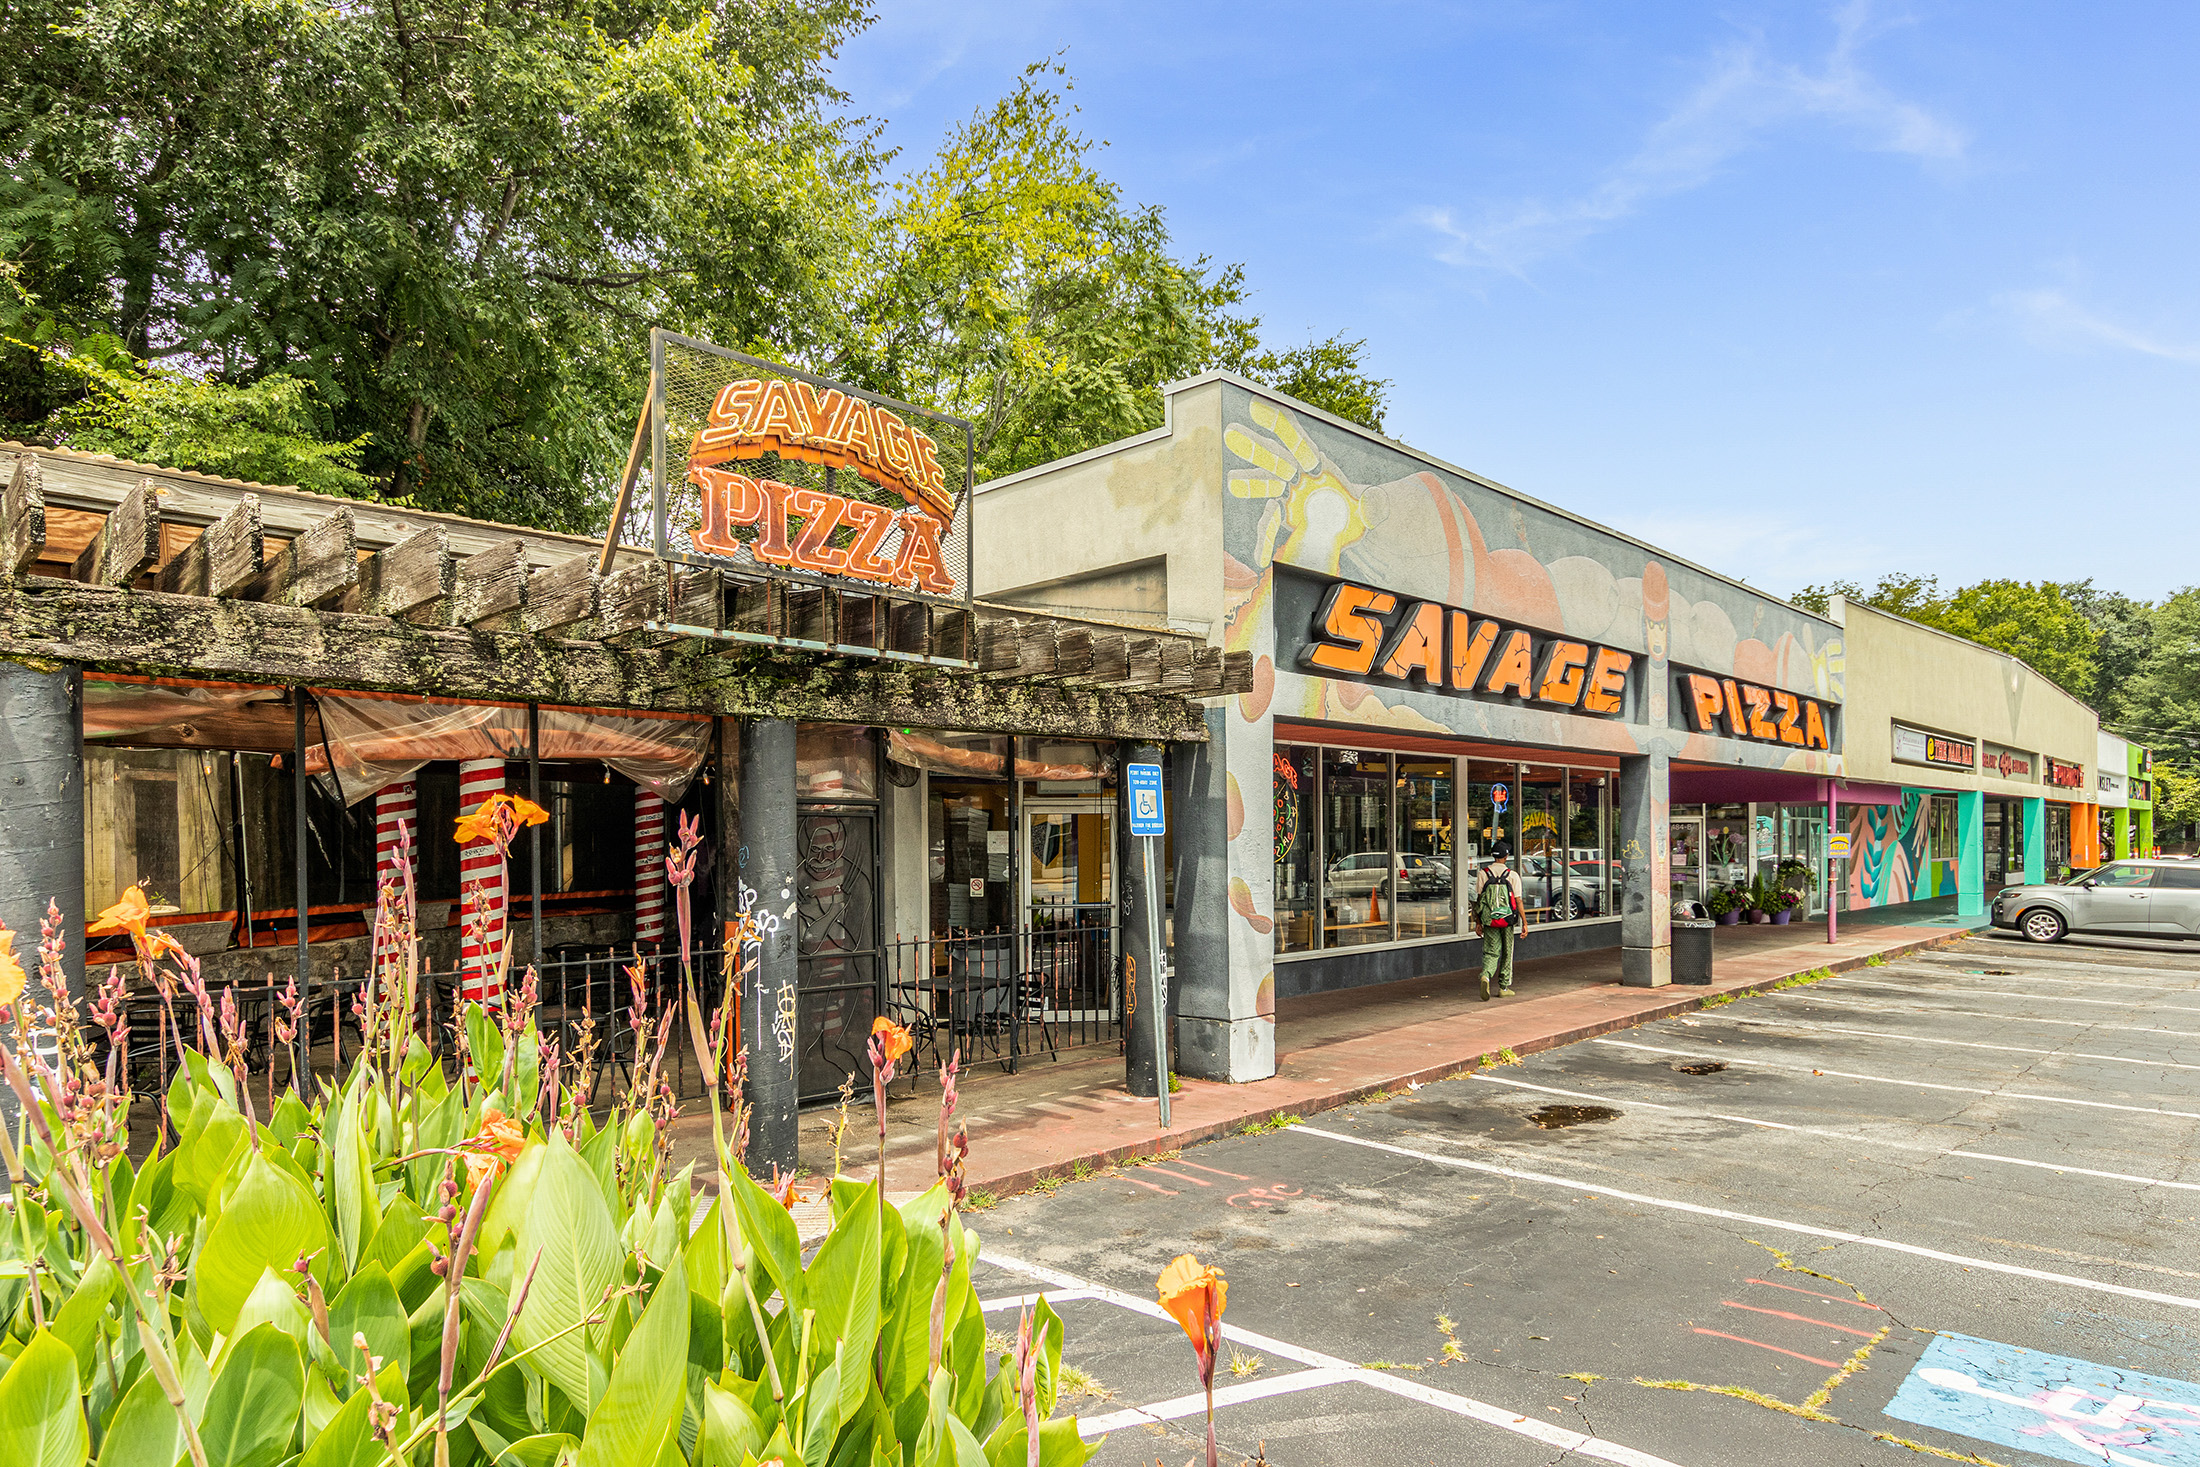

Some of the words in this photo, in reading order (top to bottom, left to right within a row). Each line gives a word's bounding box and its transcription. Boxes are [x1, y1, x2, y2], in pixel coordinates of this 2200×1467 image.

[699, 377, 957, 512] SAVAGE
[689, 466, 957, 594] PIZZA
[1305, 582, 1634, 715] SAVAGE
[1683, 673, 1830, 751] PIZZA
[1935, 739, 1947, 761] THE
[1962, 744, 1973, 766] BAR
[1521, 811, 1558, 835] SAVAGE
